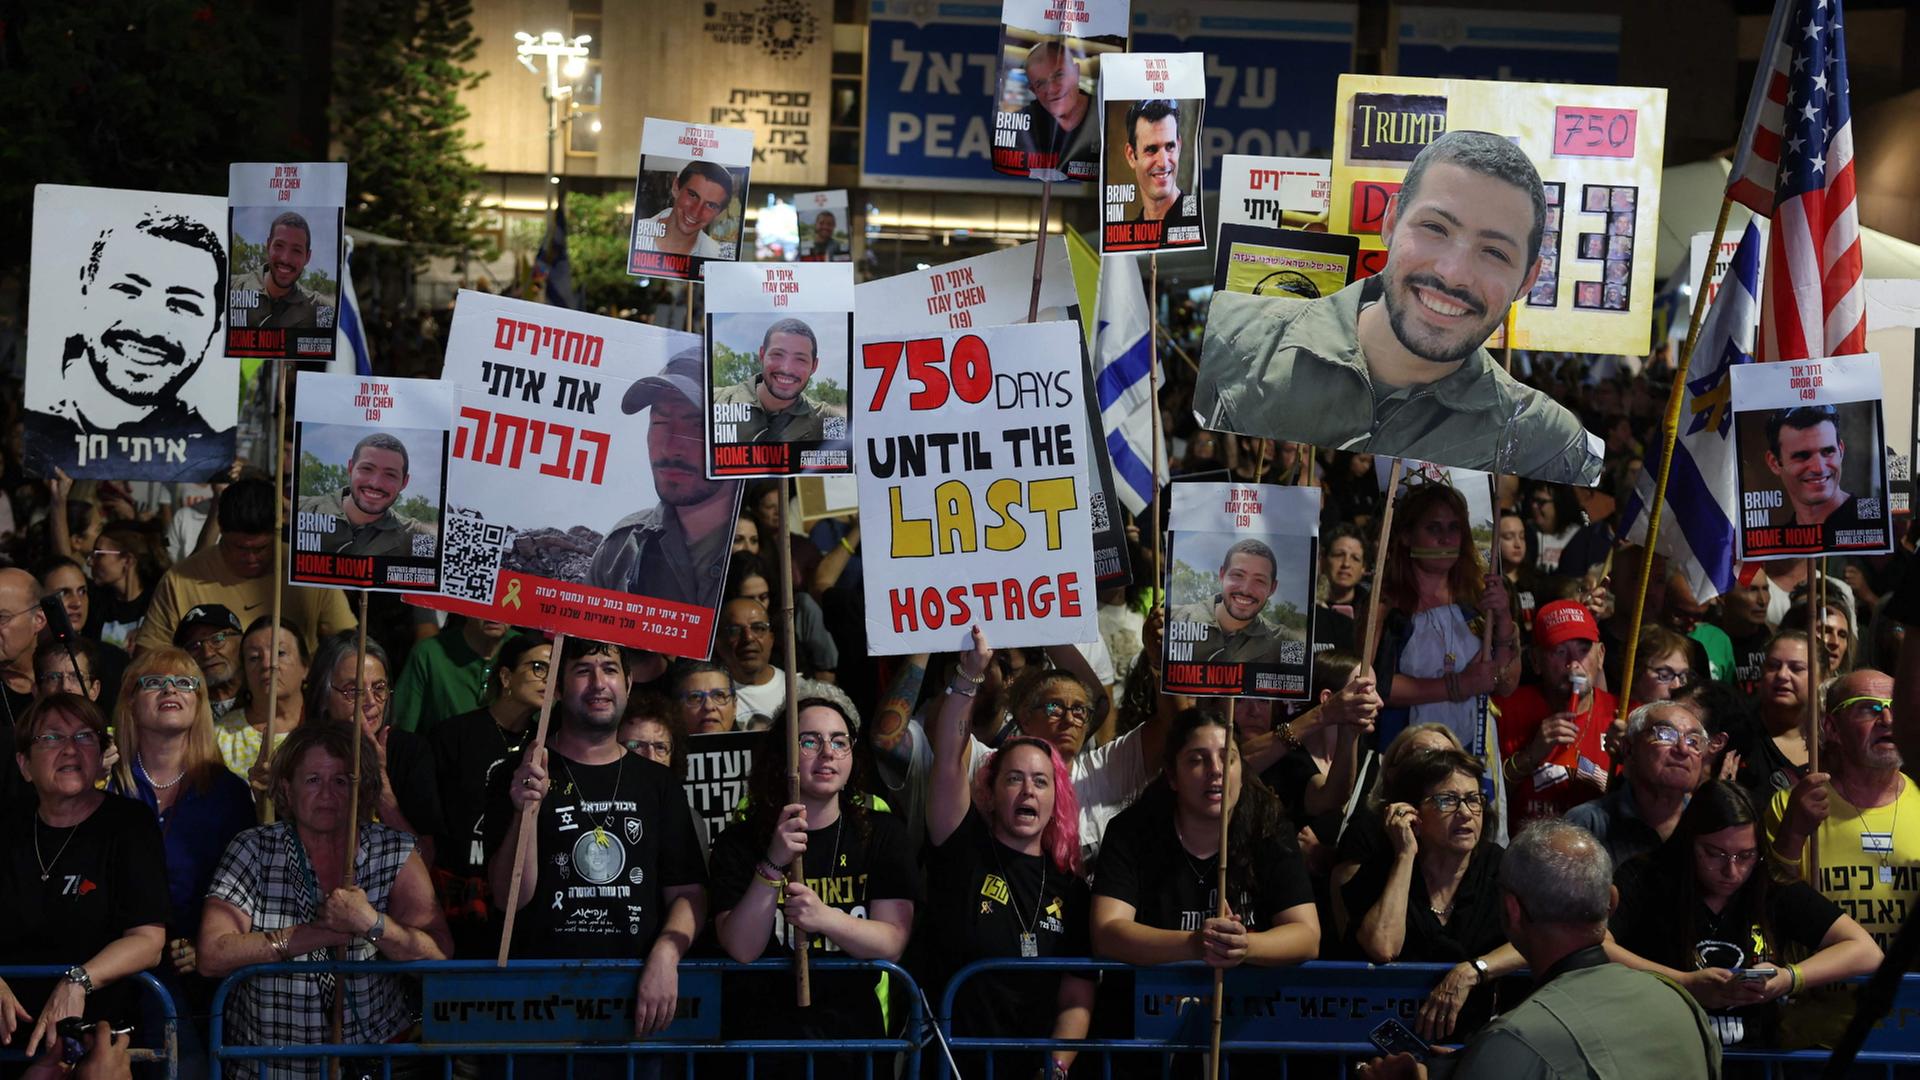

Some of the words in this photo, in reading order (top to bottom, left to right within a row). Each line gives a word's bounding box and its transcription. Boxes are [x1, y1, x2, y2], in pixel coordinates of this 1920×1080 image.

[891, 39, 996, 97] ראל
[1208, 54, 1277, 109] על
[729, 88, 811, 107] ספריית
[995, 112, 1031, 131] BRING
[1358, 105, 1447, 148] TRUMP
[1564, 113, 1629, 148] 750
[769, 128, 810, 146] בית
[887, 112, 991, 160] PEA
[994, 129, 1017, 148] HIM
[751, 147, 808, 165] אריא
[1203, 127, 1310, 169] PON
[994, 150, 1024, 167] HOME
[269, 178, 285, 189] ITAY
[285, 178, 301, 189] CHEN
[277, 189, 291, 201] (19)
[1106, 184, 1136, 203] BRING
[1106, 204, 1124, 222] HIM
[637, 219, 666, 237] BRING
[1106, 223, 1132, 243] HOME
[1134, 221, 1162, 241] NOW!
[635, 234, 655, 251] HIM
[633, 252, 661, 268] HOME
[662, 254, 690, 272] NOW!
[766, 269, 775, 281] חן
[776, 269, 794, 281] איתי
[930, 274, 945, 293] חן
[947, 267, 974, 288] איתי
[762, 282, 777, 293] ITAY
[779, 282, 799, 293] CHEN
[230, 290, 260, 308] BRING
[773, 295, 788, 307] (19)
[927, 294, 954, 316] ITAY
[955, 286, 987, 308] CHEN
[230, 309, 248, 327] HIM
[948, 309, 973, 328] (19)
[230, 330, 257, 348] HOME
[258, 328, 286, 350] NOW!
[493, 316, 605, 368] מחזירים
[862, 335, 993, 412] 750
[995, 369, 1074, 410] DAYS
[1789, 365, 1804, 377] אור
[1802, 364, 1822, 376] דרור
[360, 382, 369, 395] חן
[371, 383, 389, 396] איתי
[481, 361, 547, 405] איתי
[1789, 376, 1811, 389] DROR
[1812, 376, 1823, 388] OR
[354, 395, 371, 408] ITAY
[373, 396, 394, 409] CHEN
[552, 375, 602, 415] את
[1799, 387, 1816, 400] (48)
[365, 408, 381, 422] (19)
[714, 403, 751, 422] BRING
[714, 423, 737, 443] HIM
[75, 433, 108, 467] חן
[117, 436, 188, 463] איתי
[452, 405, 612, 486] הביתה
[715, 446, 749, 466] HOME
[752, 443, 790, 466] NOW!
[867, 430, 992, 479] UNTIL
[1003, 424, 1075, 468] THE
[1224, 502, 1242, 514] ITAY
[1242, 502, 1262, 514] CHEN
[1744, 490, 1782, 510] BRING
[297, 512, 336, 534] BRING
[890, 476, 1078, 559] LAST
[1235, 515, 1250, 528] (19)
[1746, 509, 1770, 529] HIM
[297, 532, 321, 552] HIM
[1746, 529, 1782, 548] HOME
[1785, 523, 1823, 545] NOW!
[1095, 546, 1119, 560] ISSING
[296, 553, 333, 575] HOME
[336, 556, 374, 578] NOW!
[387, 573, 413, 583] FAMILIES
[413, 575, 436, 585] FORUM
[535, 586, 557, 598] לעזה
[559, 591, 584, 604] ונחטף
[587, 595, 601, 607] עוז
[540, 602, 557, 614] לעד
[603, 598, 623, 611] בנחל
[626, 603, 644, 615] לחם
[646, 606, 656, 617] חן
[889, 571, 1082, 634] HOSTAGE
[559, 606, 581, 620] שלנו
[584, 611, 616, 625] האריות
[658, 608, 678, 620] איתי
[619, 618, 636, 629] מלך
[642, 621, 679, 637] 7.10.23
[1169, 621, 1209, 642] BRING
[680, 629, 688, 639] ב
[1168, 641, 1193, 662] HIM
[1167, 663, 1204, 685] HOME
[1206, 663, 1243, 686] NOW!
[686, 749, 752, 782] ועדת
[984, 875, 1008, 901] 750
